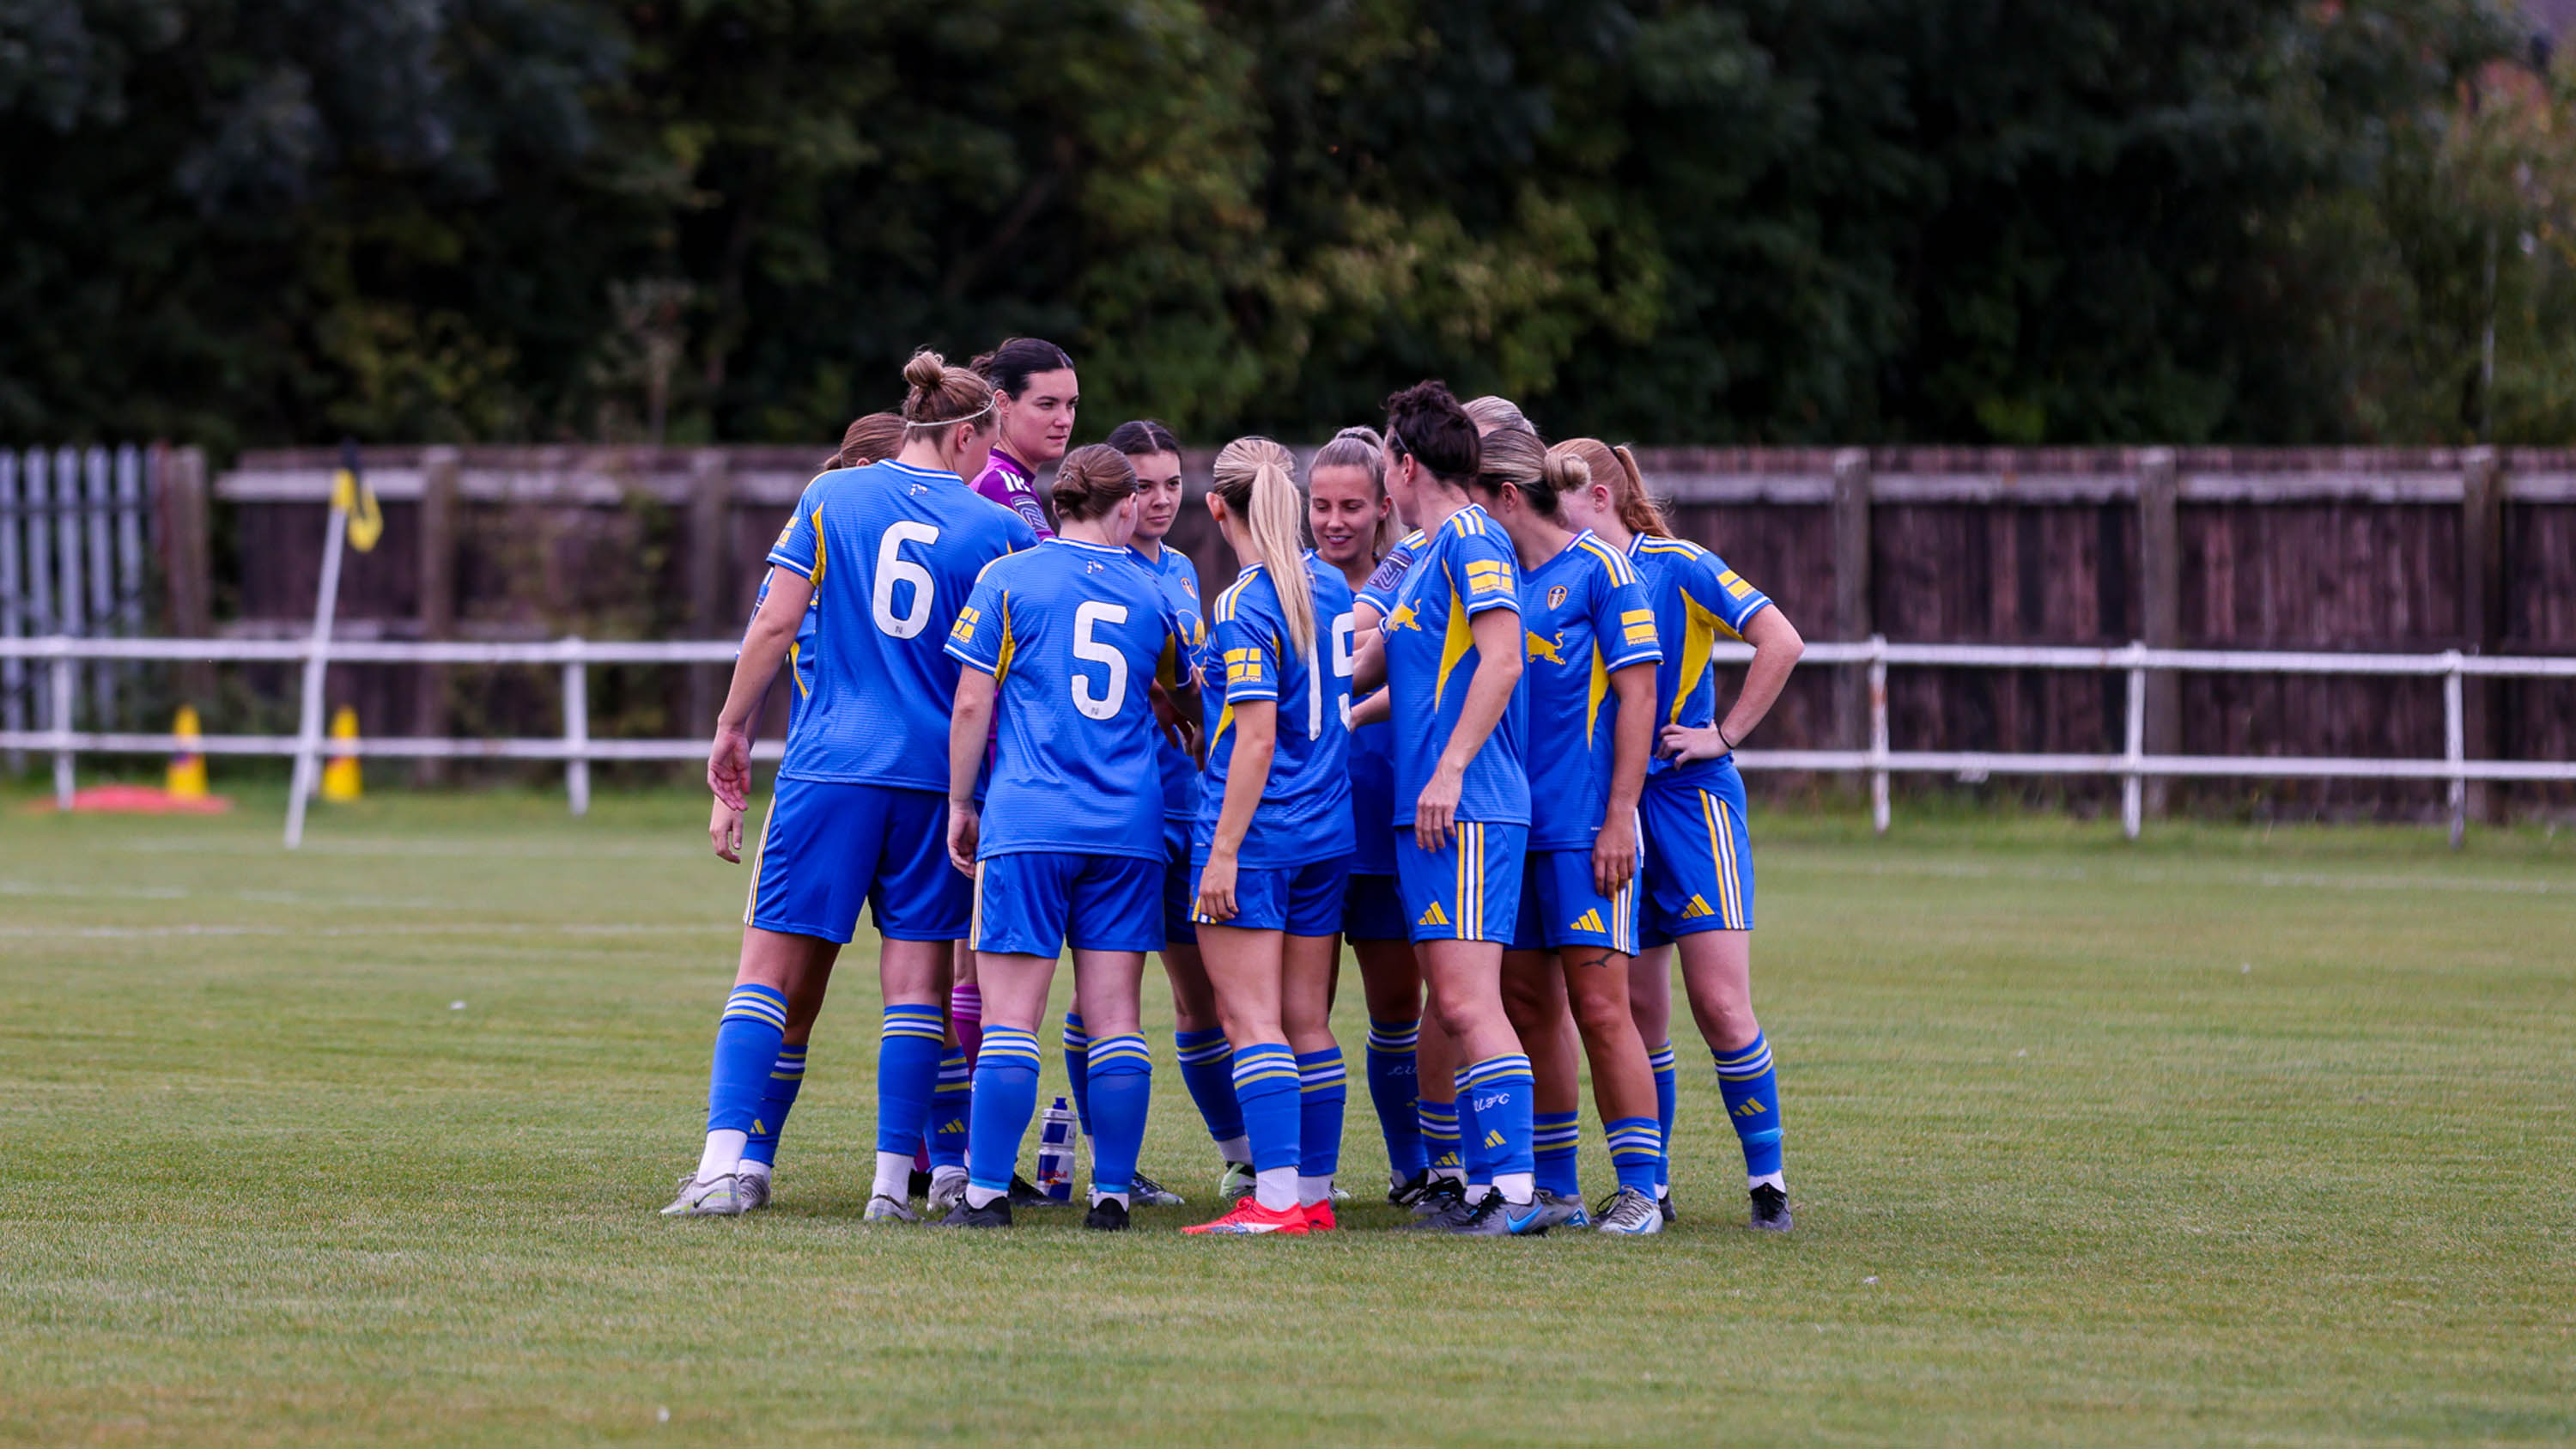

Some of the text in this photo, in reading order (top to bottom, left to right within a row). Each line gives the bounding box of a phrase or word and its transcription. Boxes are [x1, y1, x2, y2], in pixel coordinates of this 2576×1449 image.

[872, 521, 941, 639] 6
[1072, 600, 1128, 721] 5
[1473, 1093, 1510, 1112] UFC
